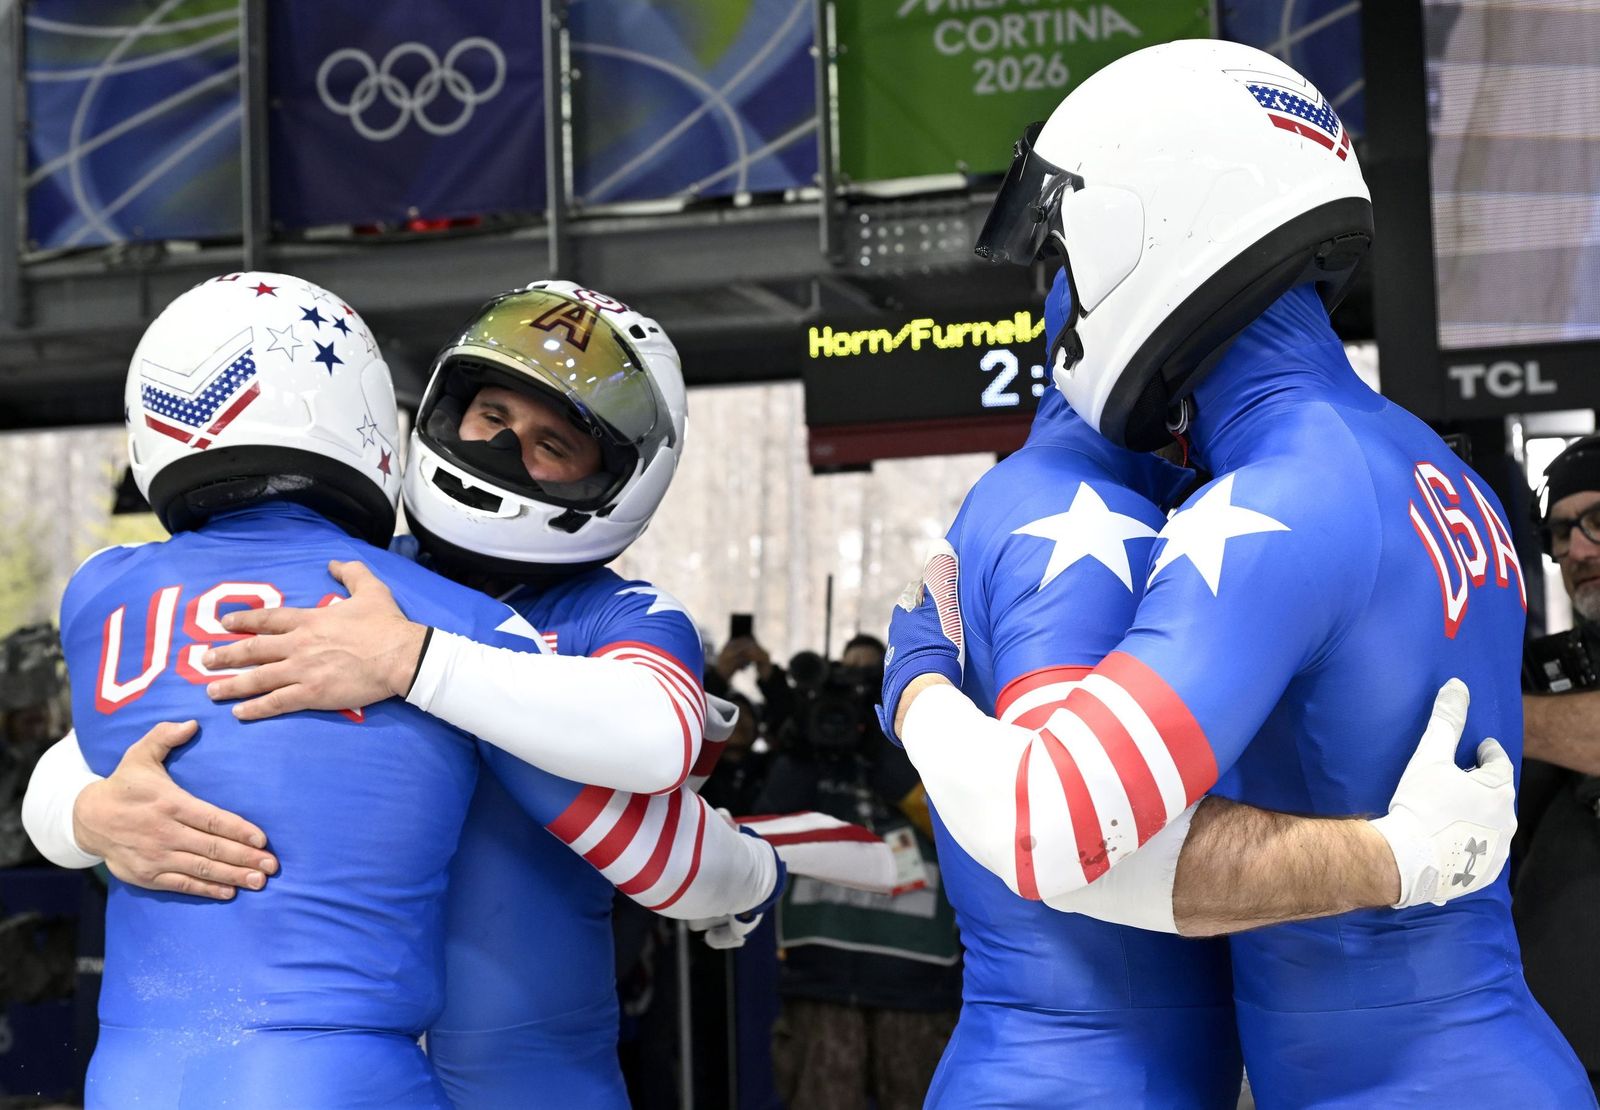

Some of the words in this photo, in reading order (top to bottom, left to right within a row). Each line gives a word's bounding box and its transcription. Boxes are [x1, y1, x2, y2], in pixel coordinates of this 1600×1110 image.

[934, 5, 1141, 54] CORTINA
[973, 53, 1069, 95] 2026
[1448, 361, 1558, 399] TCL
[1409, 461, 1527, 640] USA
[95, 581, 365, 723] US
